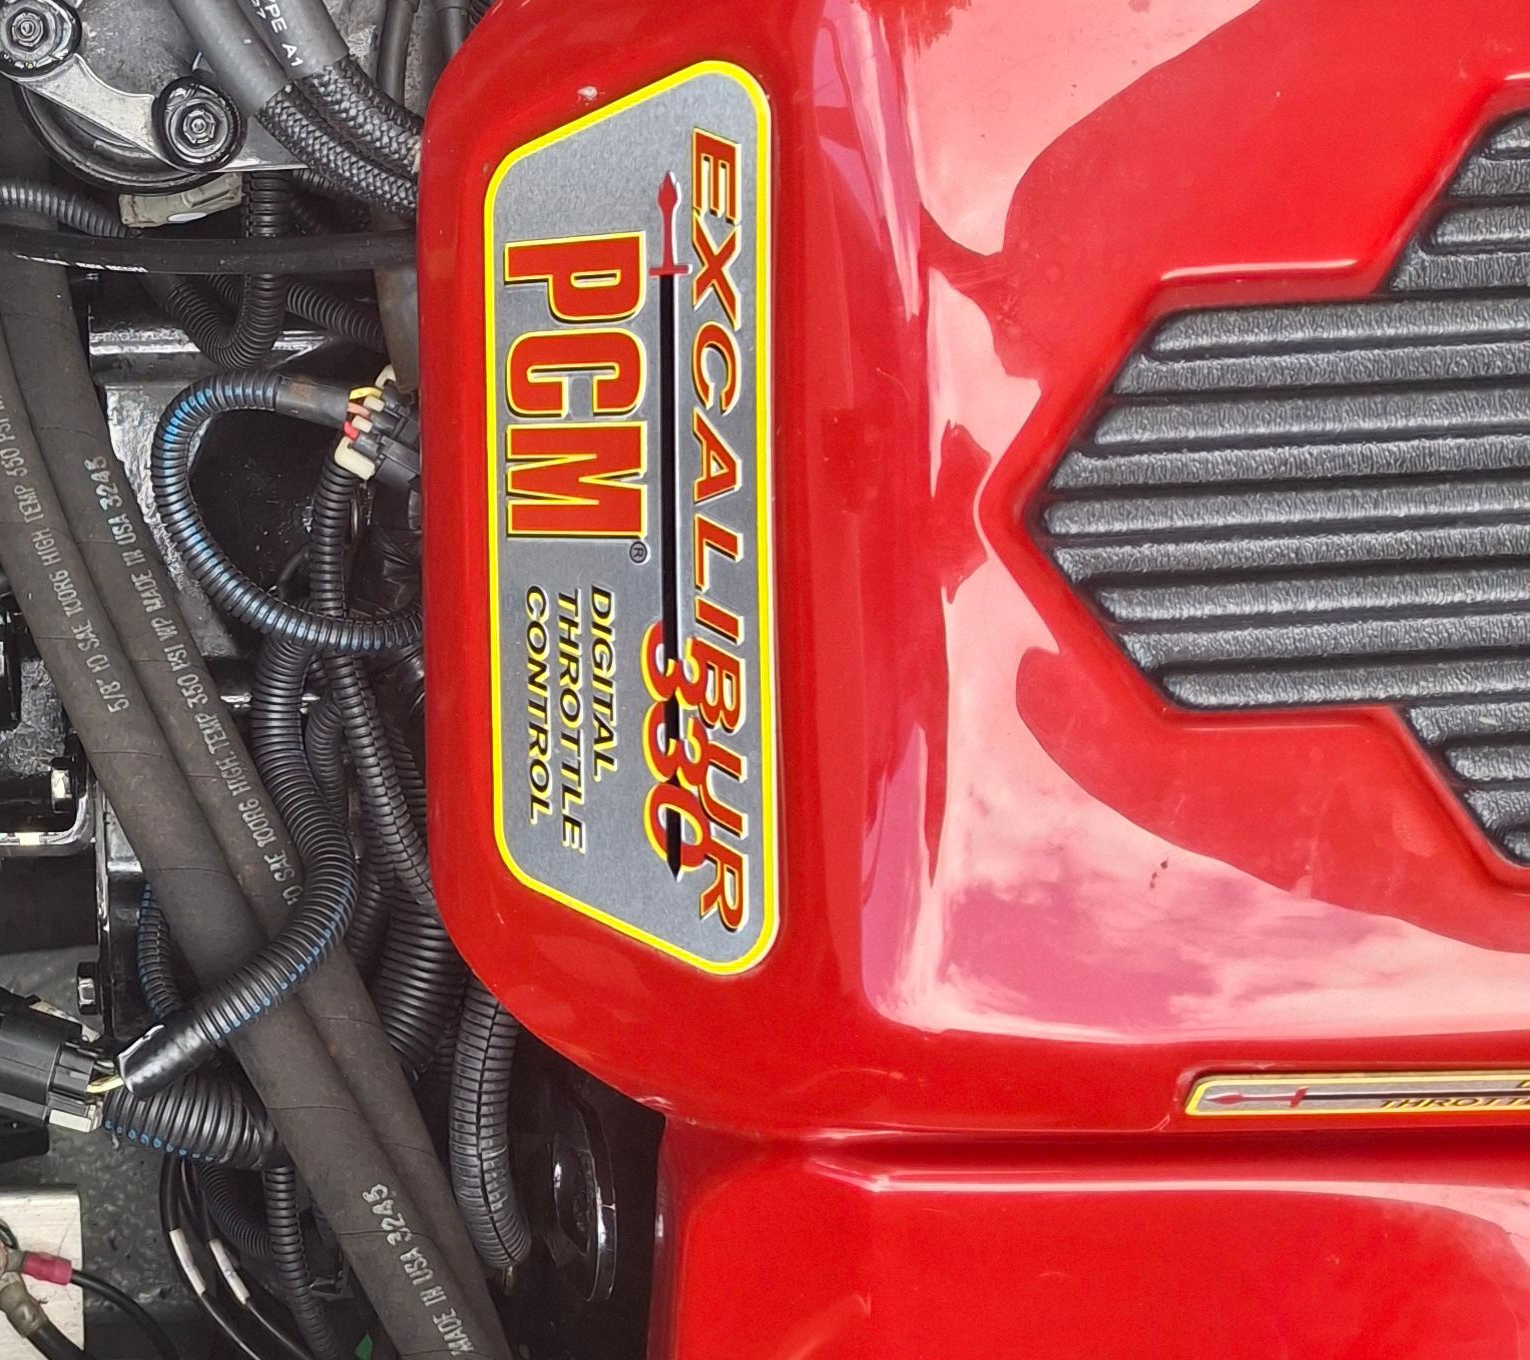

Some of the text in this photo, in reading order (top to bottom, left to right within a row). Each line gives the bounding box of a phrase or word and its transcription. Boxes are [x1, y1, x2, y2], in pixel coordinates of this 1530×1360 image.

[281, 43, 304, 67] A1
[31, 527, 62, 568] HIGH
[106, 516, 137, 545] USA
[692, 128, 749, 933] EXCALIBUR
[122, 548, 145, 568] IN
[130, 573, 166, 613] MADE
[69, 619, 100, 653] SAE
[149, 616, 177, 642] WP
[85, 654, 111, 674] ID
[590, 585, 618, 782] DIGITAL
[176, 674, 208, 709] 350
[526, 585, 553, 825] CONTROL
[194, 713, 230, 755] TEMP
[557, 586, 587, 855] THROTTLE
[641, 618, 713, 872] 330
[238, 798, 277, 848] 100R6
[263, 850, 295, 883] SAE
[400, 1246, 433, 1284] USA
[417, 1285, 448, 1306] IN
[432, 1307, 474, 1356] MADE
